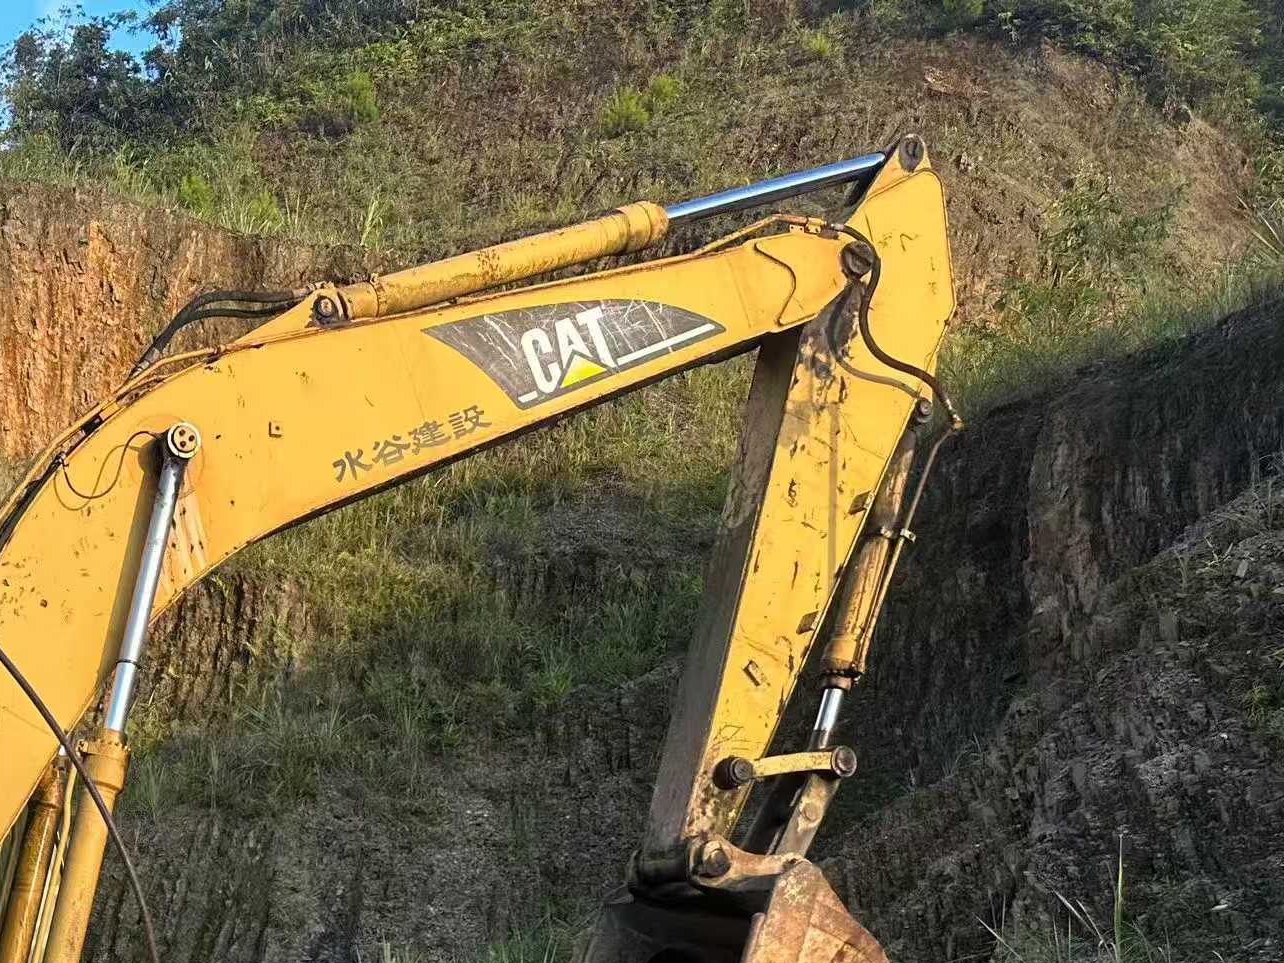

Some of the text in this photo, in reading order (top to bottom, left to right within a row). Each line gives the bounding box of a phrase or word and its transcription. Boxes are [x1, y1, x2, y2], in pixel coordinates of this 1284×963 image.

[521, 306, 616, 393] CAT
[332, 404, 493, 483] 水谷建設
